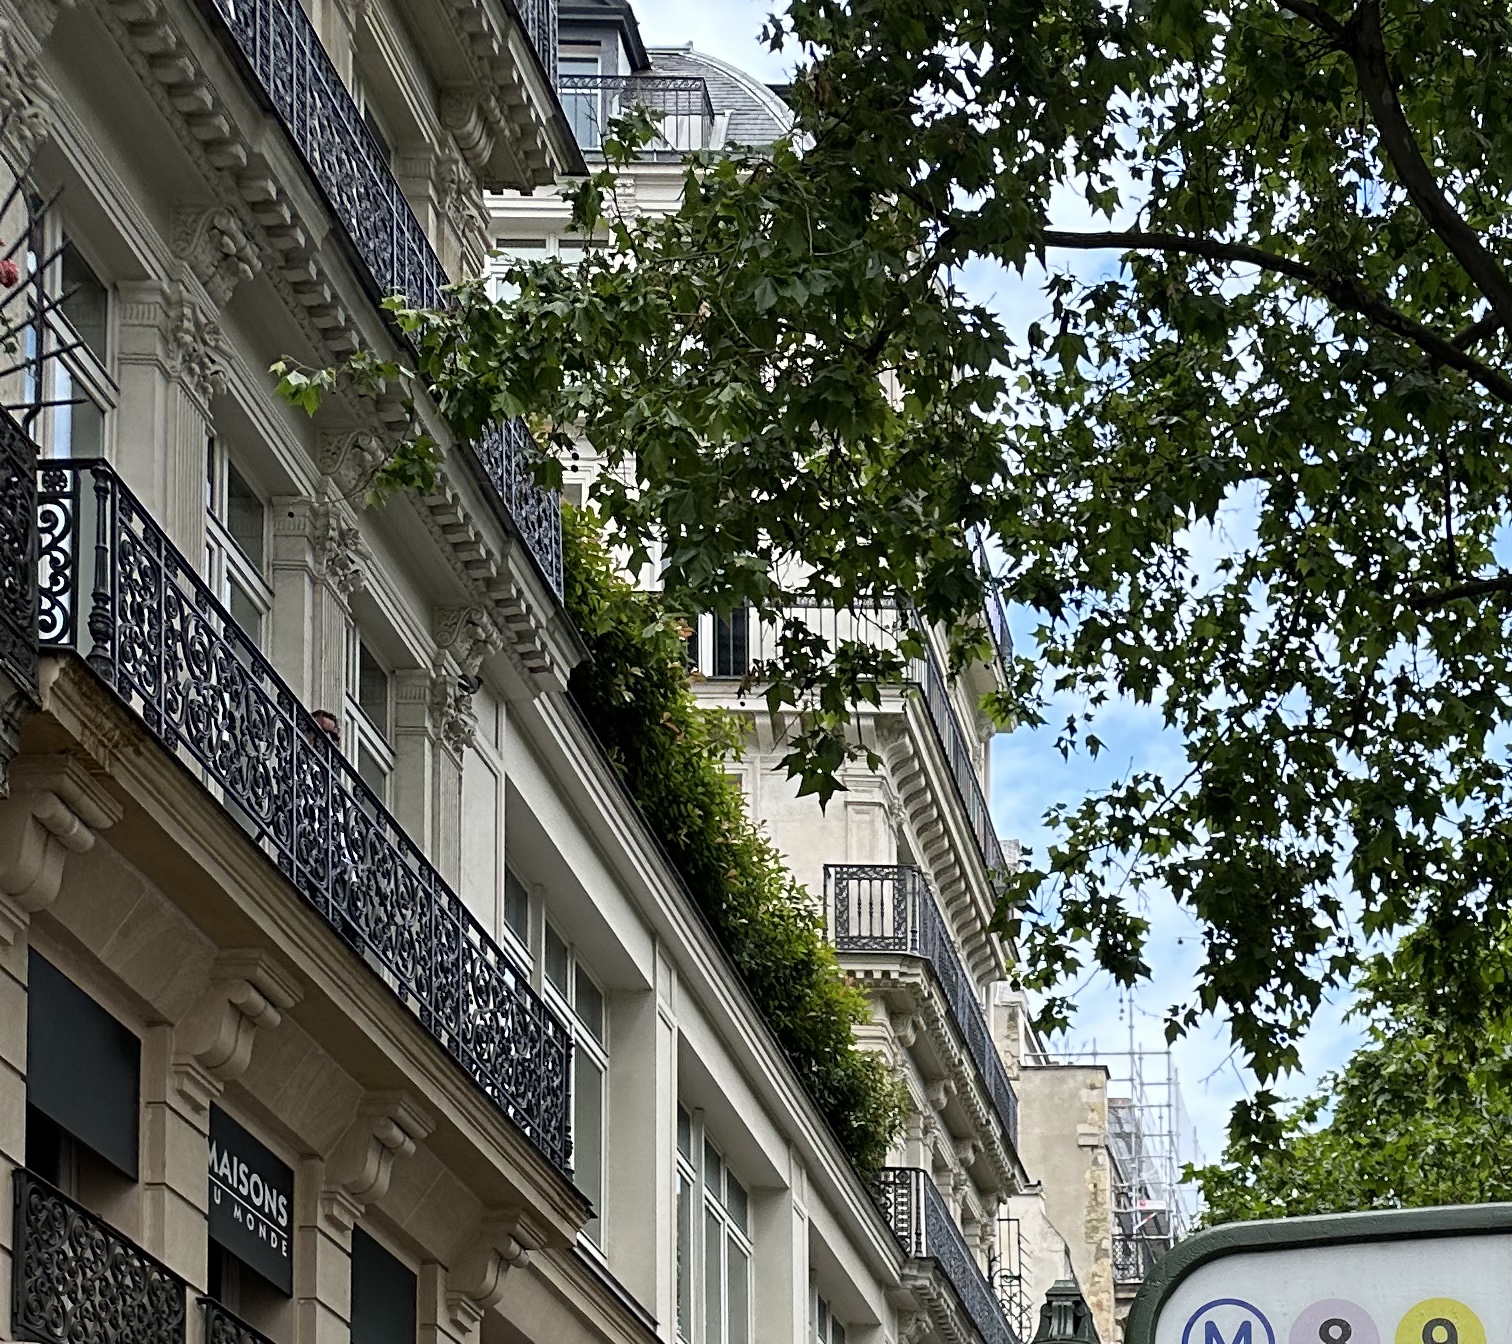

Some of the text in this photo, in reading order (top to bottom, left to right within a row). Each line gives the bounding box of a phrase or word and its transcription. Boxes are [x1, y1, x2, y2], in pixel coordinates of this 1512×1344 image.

[208, 1140, 288, 1227] MAISONS
[212, 1185, 288, 1257] U MONDE
